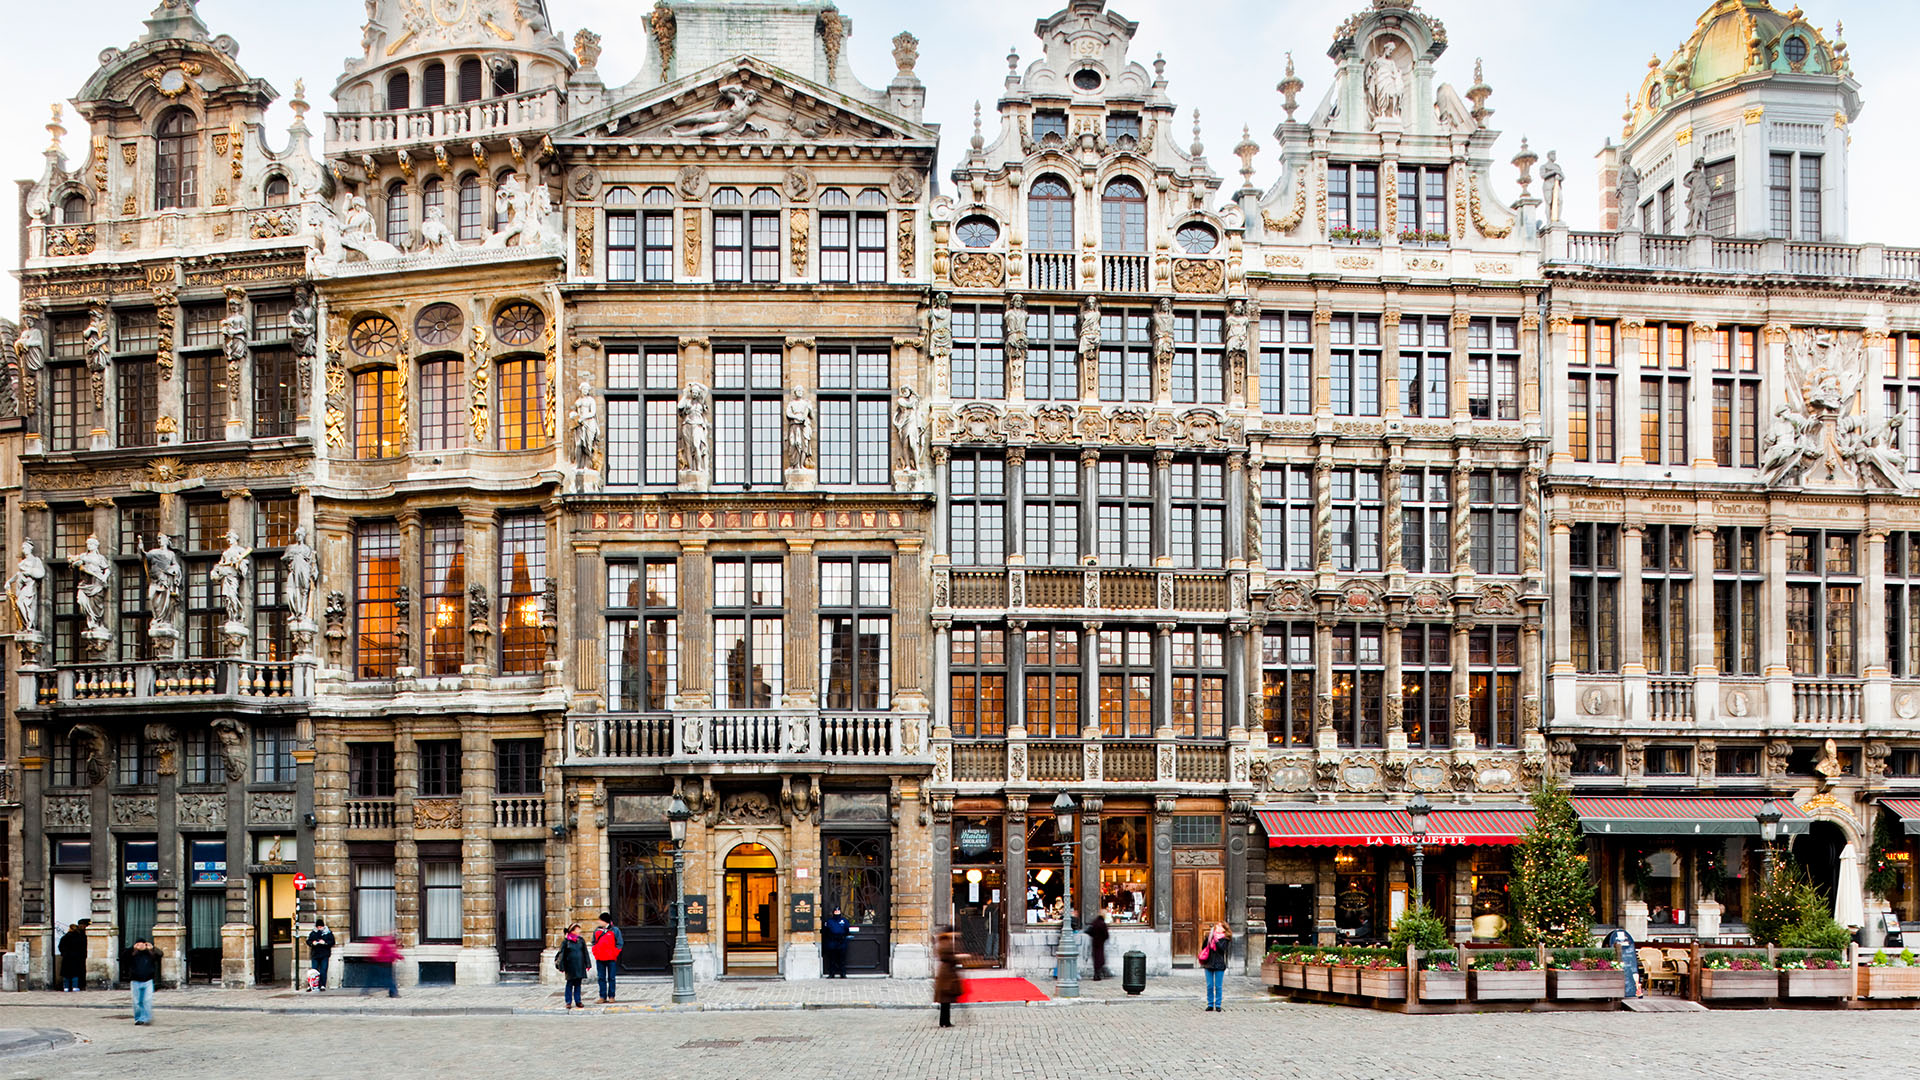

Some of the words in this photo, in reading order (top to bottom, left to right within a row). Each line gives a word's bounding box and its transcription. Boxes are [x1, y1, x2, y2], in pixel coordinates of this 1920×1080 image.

[1073, 41, 1102, 54] 1697
[147, 266, 175, 282] 1699
[1651, 502, 1683, 512] PISTOR
[1366, 836, 1384, 845] LA
[1392, 836, 1466, 845] BROUETTE
